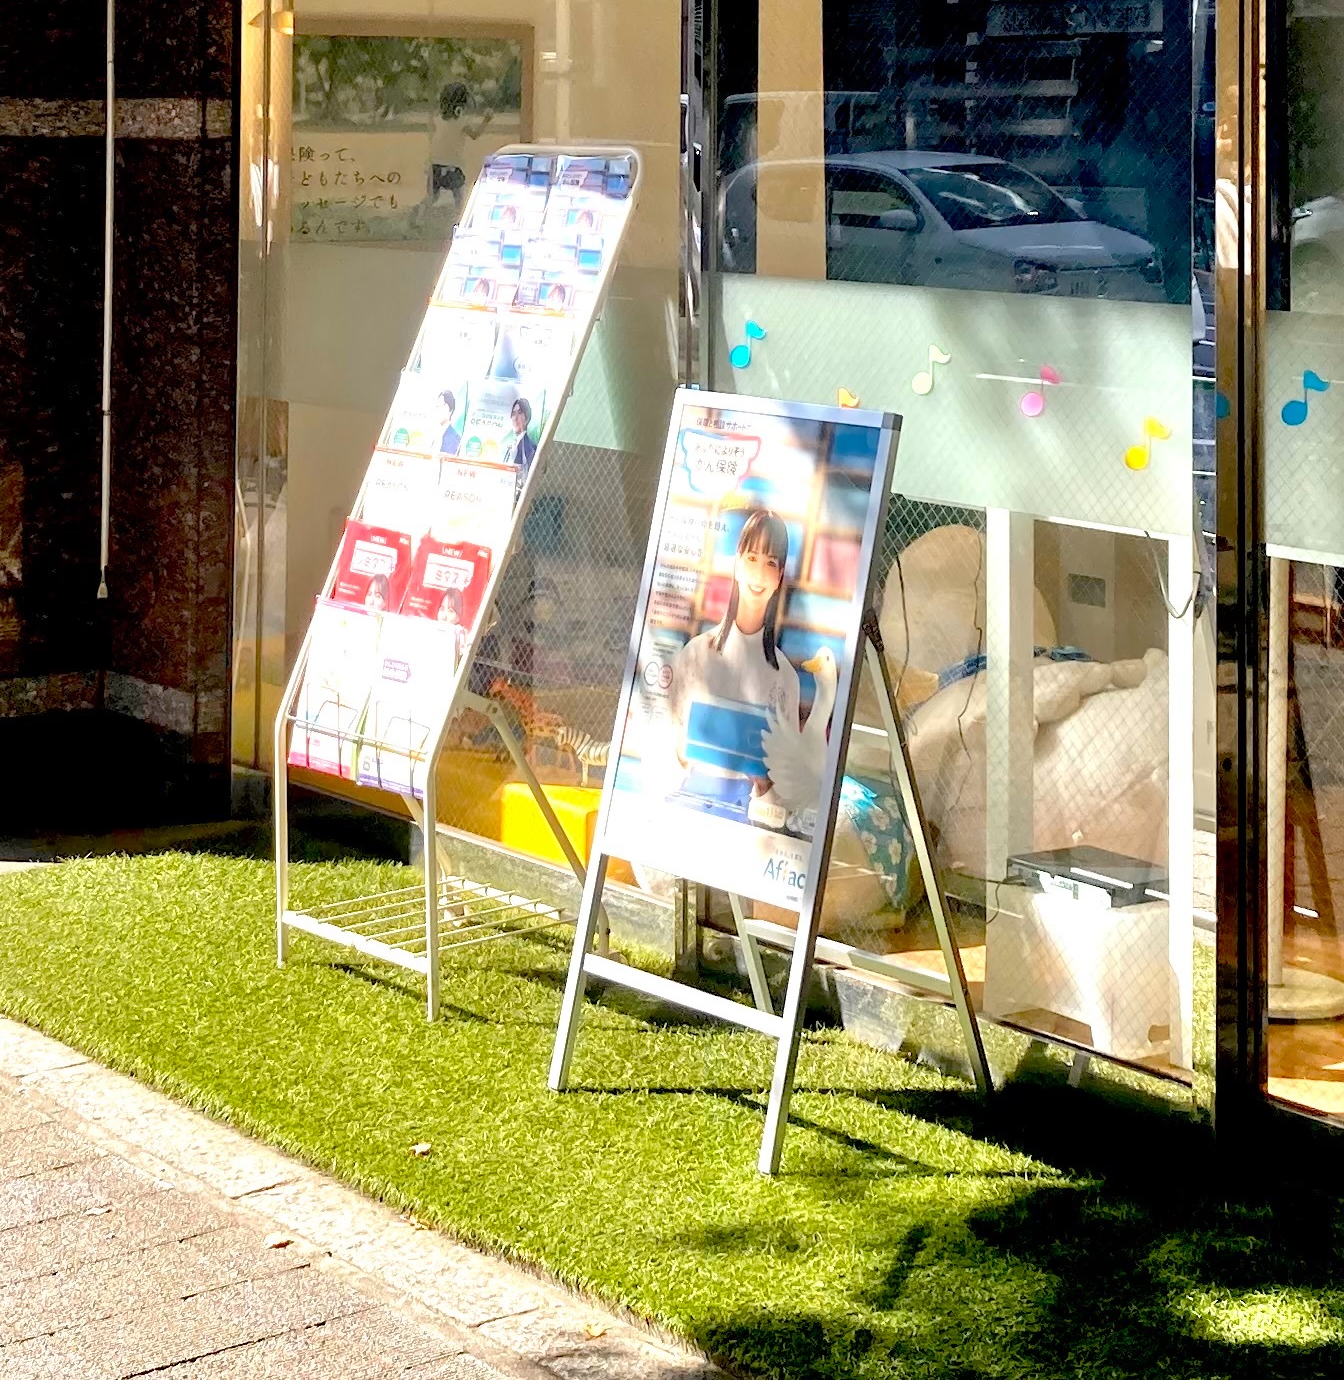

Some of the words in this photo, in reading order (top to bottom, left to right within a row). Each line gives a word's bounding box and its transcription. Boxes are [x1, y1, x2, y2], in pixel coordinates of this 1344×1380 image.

[293, 171, 402, 187] どもたちへの
